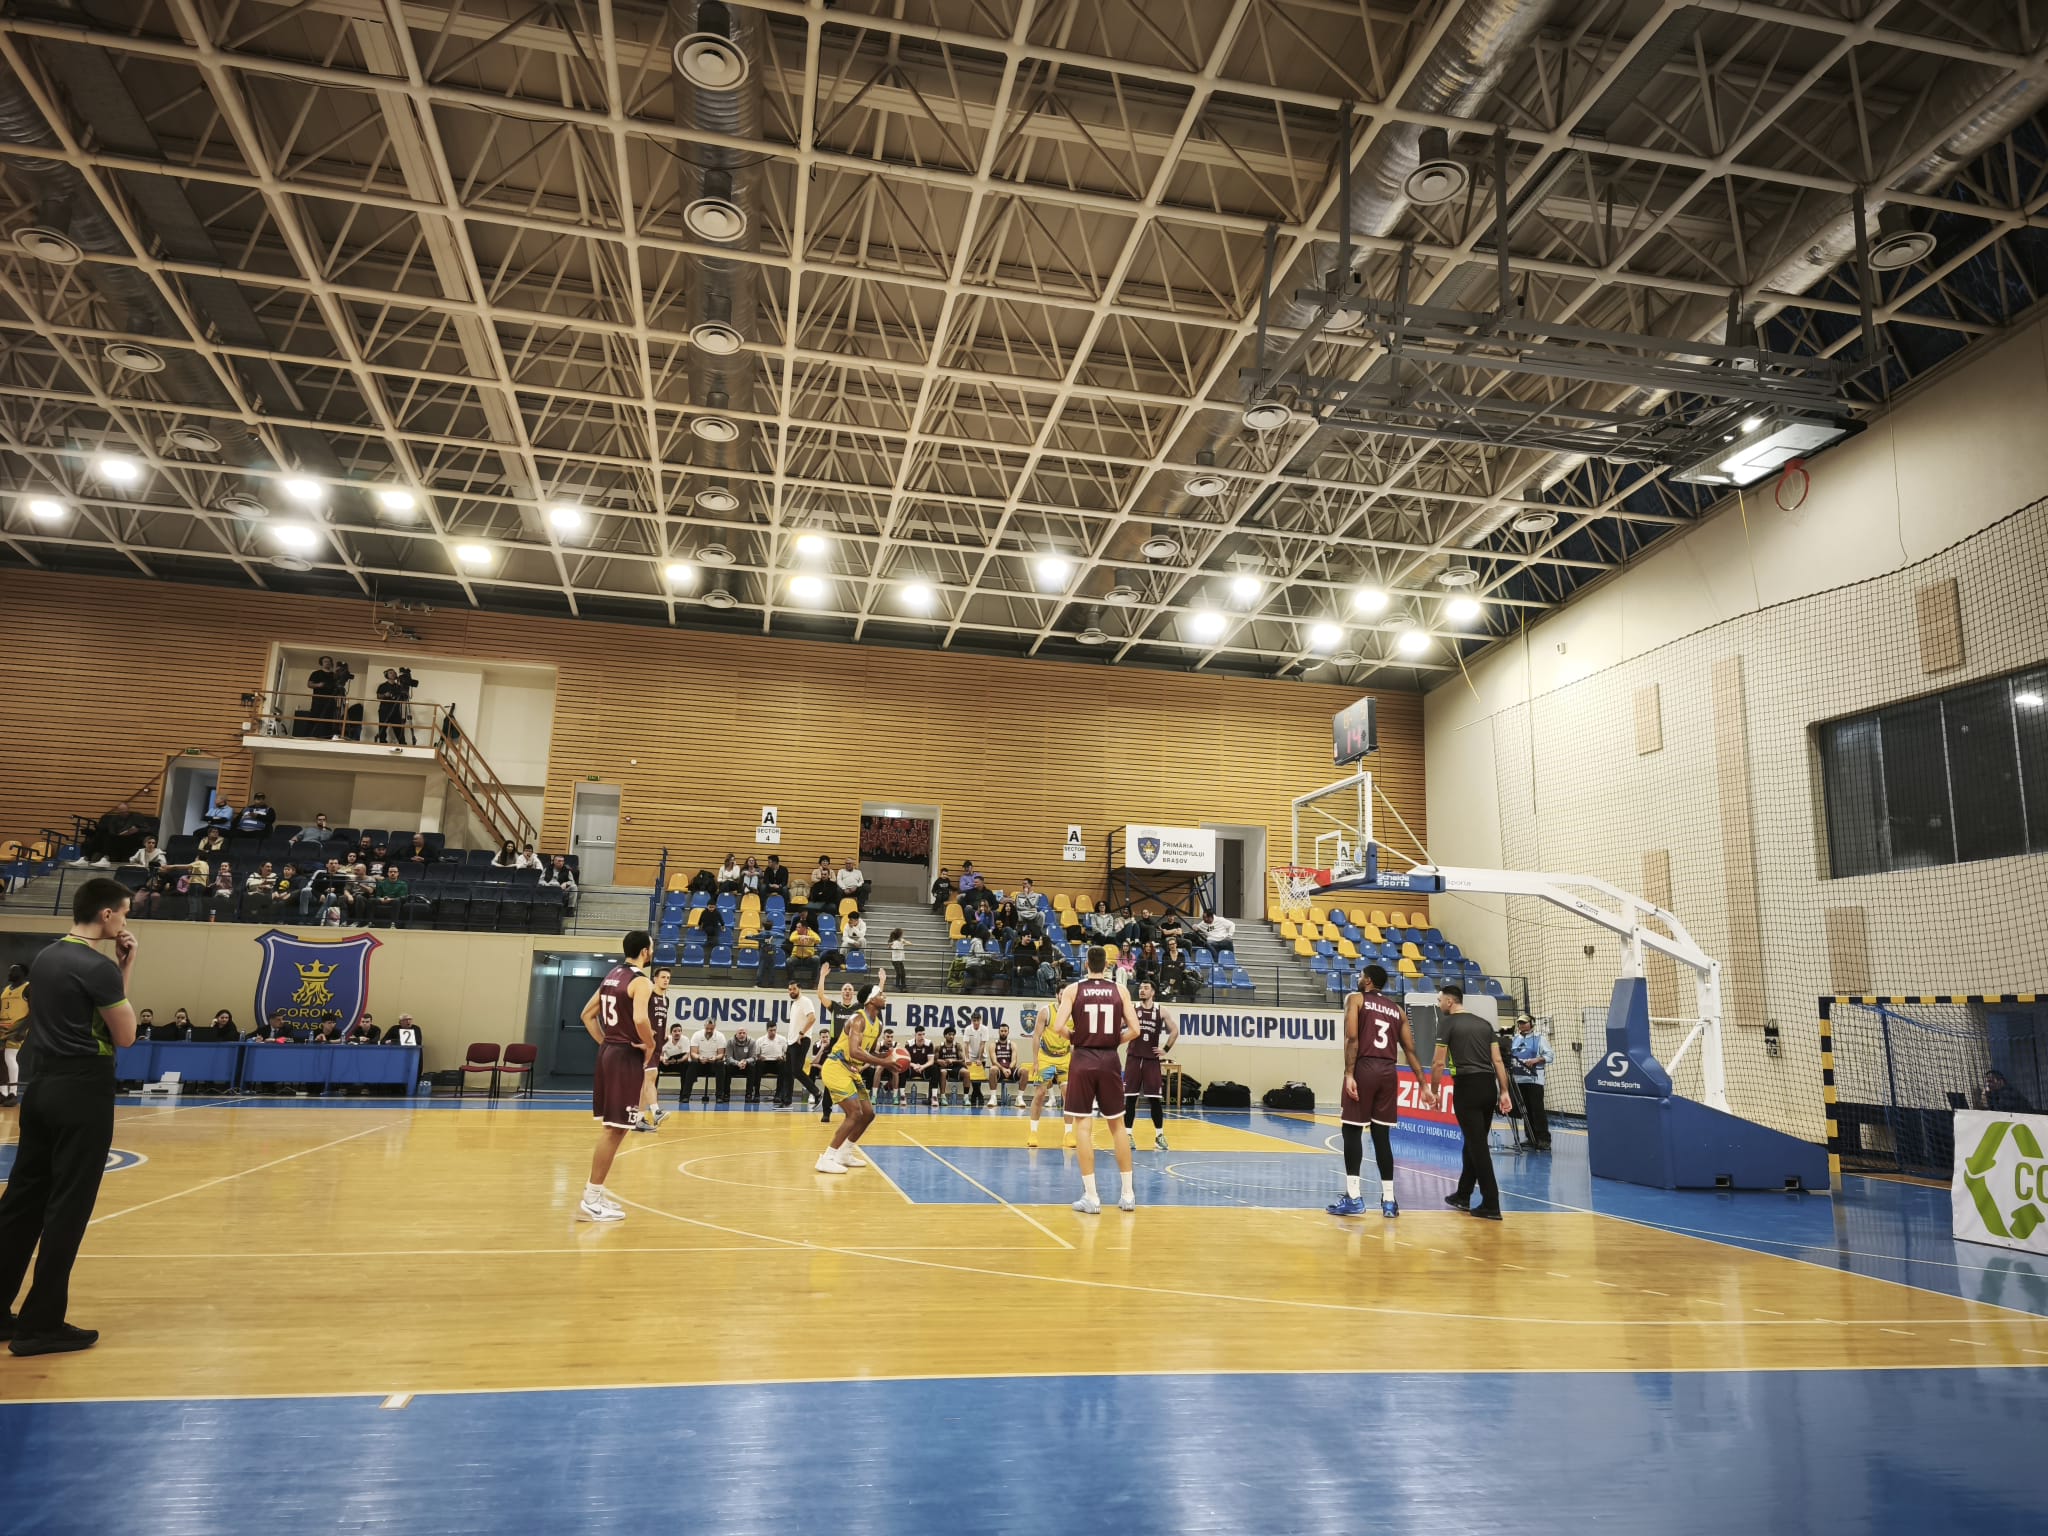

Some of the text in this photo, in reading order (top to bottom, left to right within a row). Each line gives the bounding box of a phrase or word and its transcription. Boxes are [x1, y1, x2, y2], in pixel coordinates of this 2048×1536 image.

[763, 811, 775, 824] A
[1069, 830, 1080, 843] A
[1162, 849, 1205, 857] MUNICIPIULUI
[1377, 880, 1410, 888] Sports
[276, 1007, 343, 1019] CORONA
[600, 994, 619, 1027] 13
[1364, 1001, 1400, 1020] SULLIVAN
[1084, 1004, 1114, 1034] 11
[1179, 1013, 1336, 1041] MUNICIPIULUI
[1373, 1018, 1391, 1049] 3
[402, 1030, 413, 1044] 2
[628, 1111, 637, 1123] 13
[1400, 1121, 1417, 1133] PASUL
